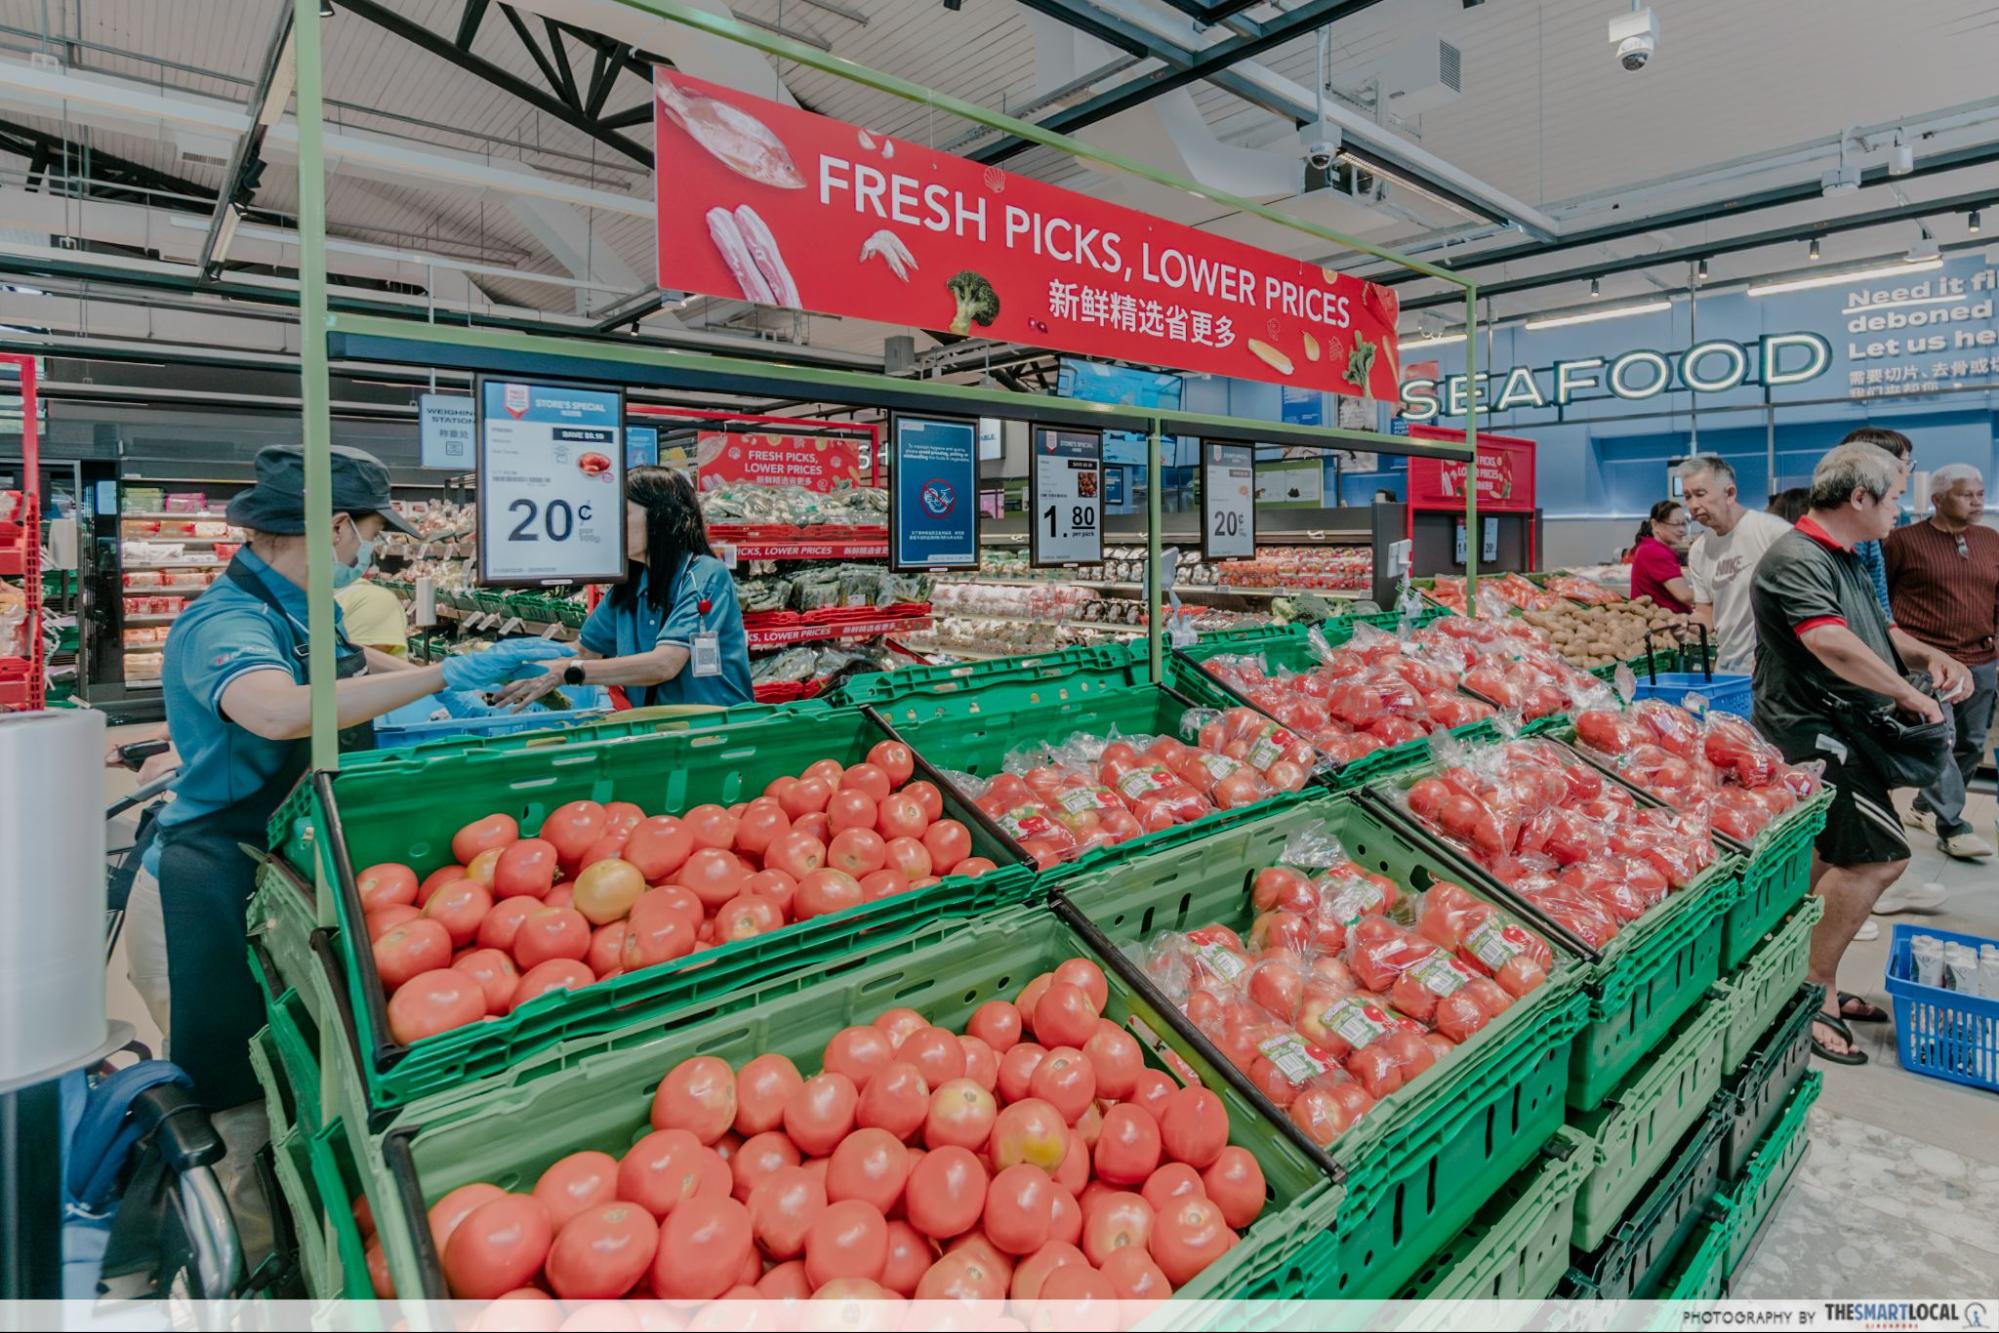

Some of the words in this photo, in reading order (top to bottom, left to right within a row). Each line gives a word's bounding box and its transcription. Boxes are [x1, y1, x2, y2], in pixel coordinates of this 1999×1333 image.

[819, 154, 986, 242] FRESH
[1005, 204, 1132, 282] PICKS,
[1142, 242, 1257, 306] LOWER
[1265, 276, 1351, 329] PRICES
[1848, 281, 1931, 307] Need
[1940, 276, 1965, 296] it
[1049, 279, 1237, 348] 新鲜精选省更多
[1847, 300, 1994, 334] deboned
[1848, 339, 1900, 361] Let
[1907, 335, 1947, 354] us
[1954, 329, 1999, 349] he
[1400, 331, 1832, 421] SEAFOOD
[744, 463, 784, 474] LOWER
[787, 464, 823, 475] PRICES
[748, 450, 783, 461] FRESH
[785, 451, 819, 464] PICKS,
[764, 545, 799, 555] LOWER
[800, 545, 832, 555] PRICES
[764, 630, 799, 641] LOWER
[800, 627, 831, 637] PRICES
